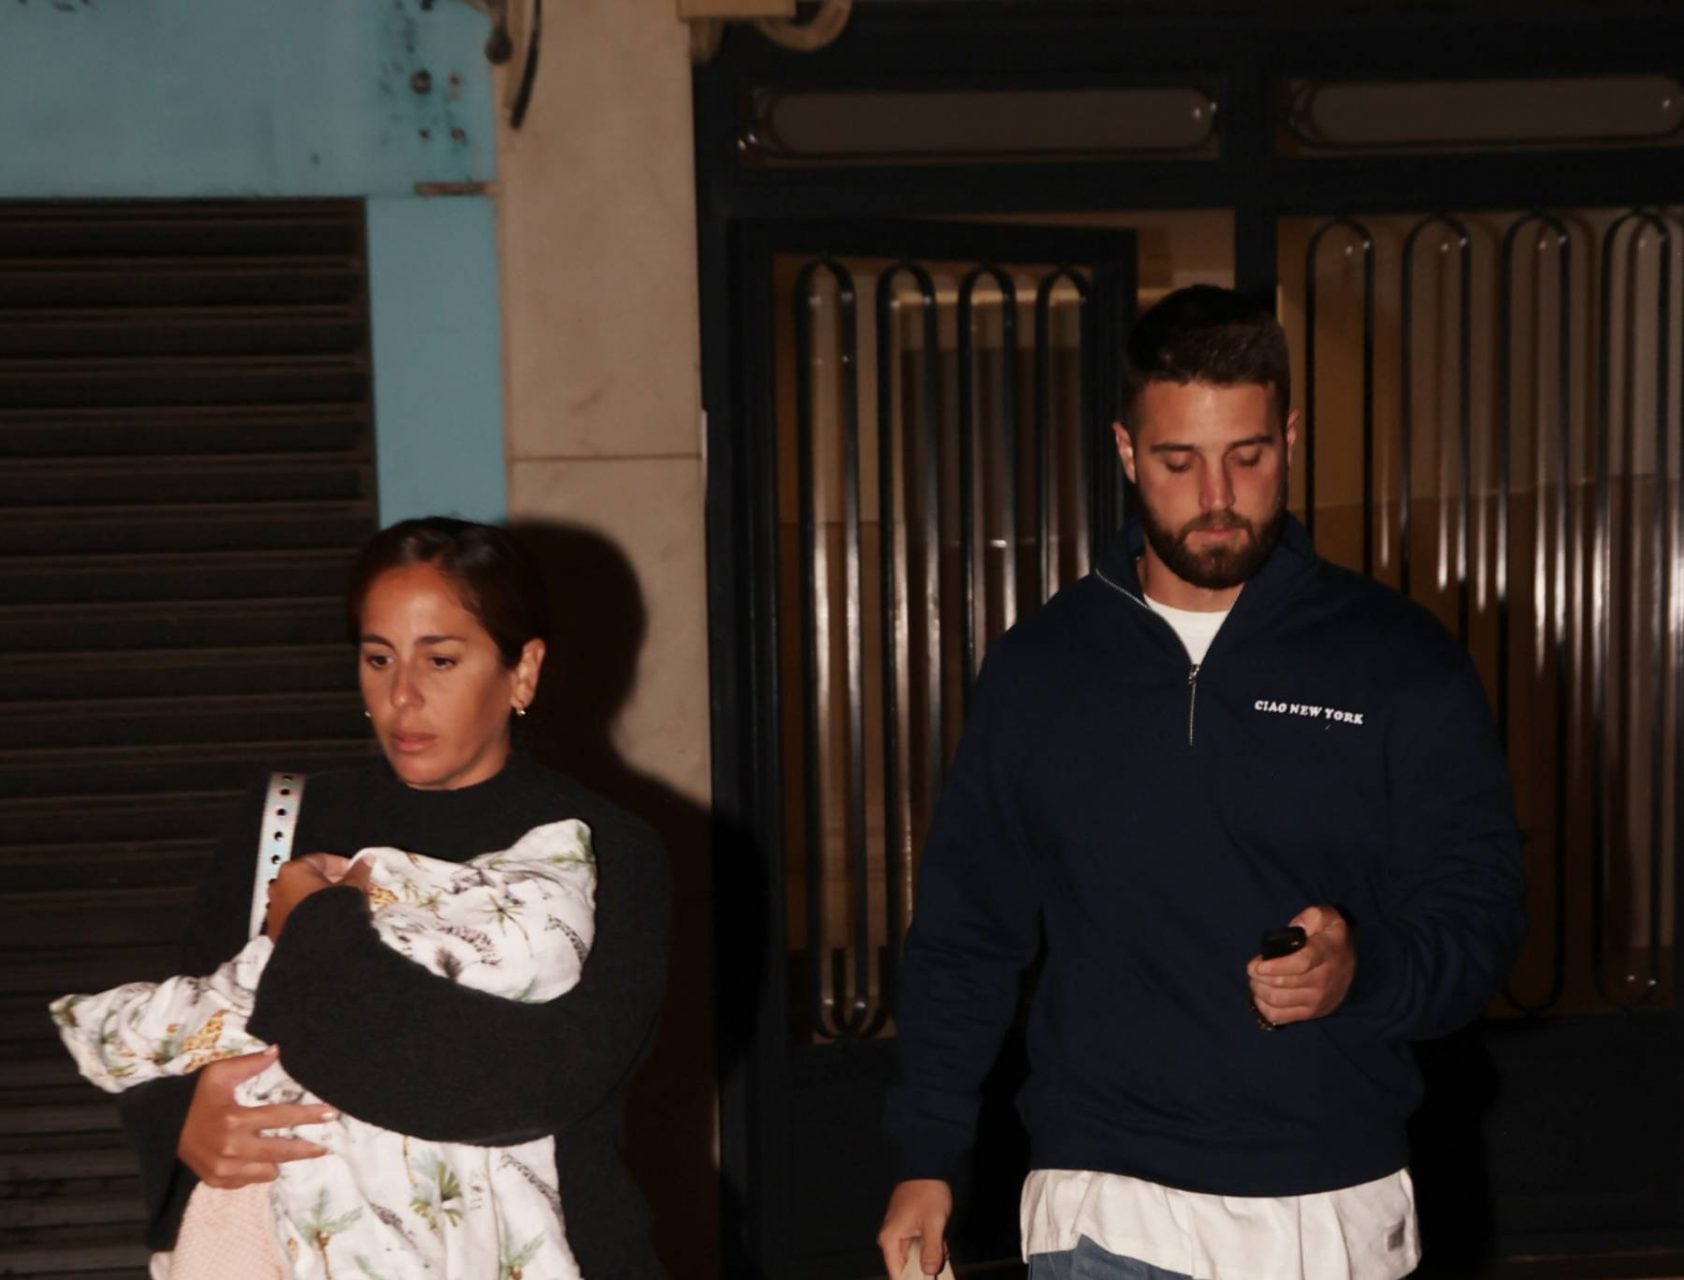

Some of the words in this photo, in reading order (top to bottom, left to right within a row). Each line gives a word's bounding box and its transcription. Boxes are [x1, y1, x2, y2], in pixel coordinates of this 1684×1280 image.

[1254, 700, 1288, 713] CIAO
[1289, 703, 1322, 717] NEW
[1325, 708, 1364, 725] YORK
